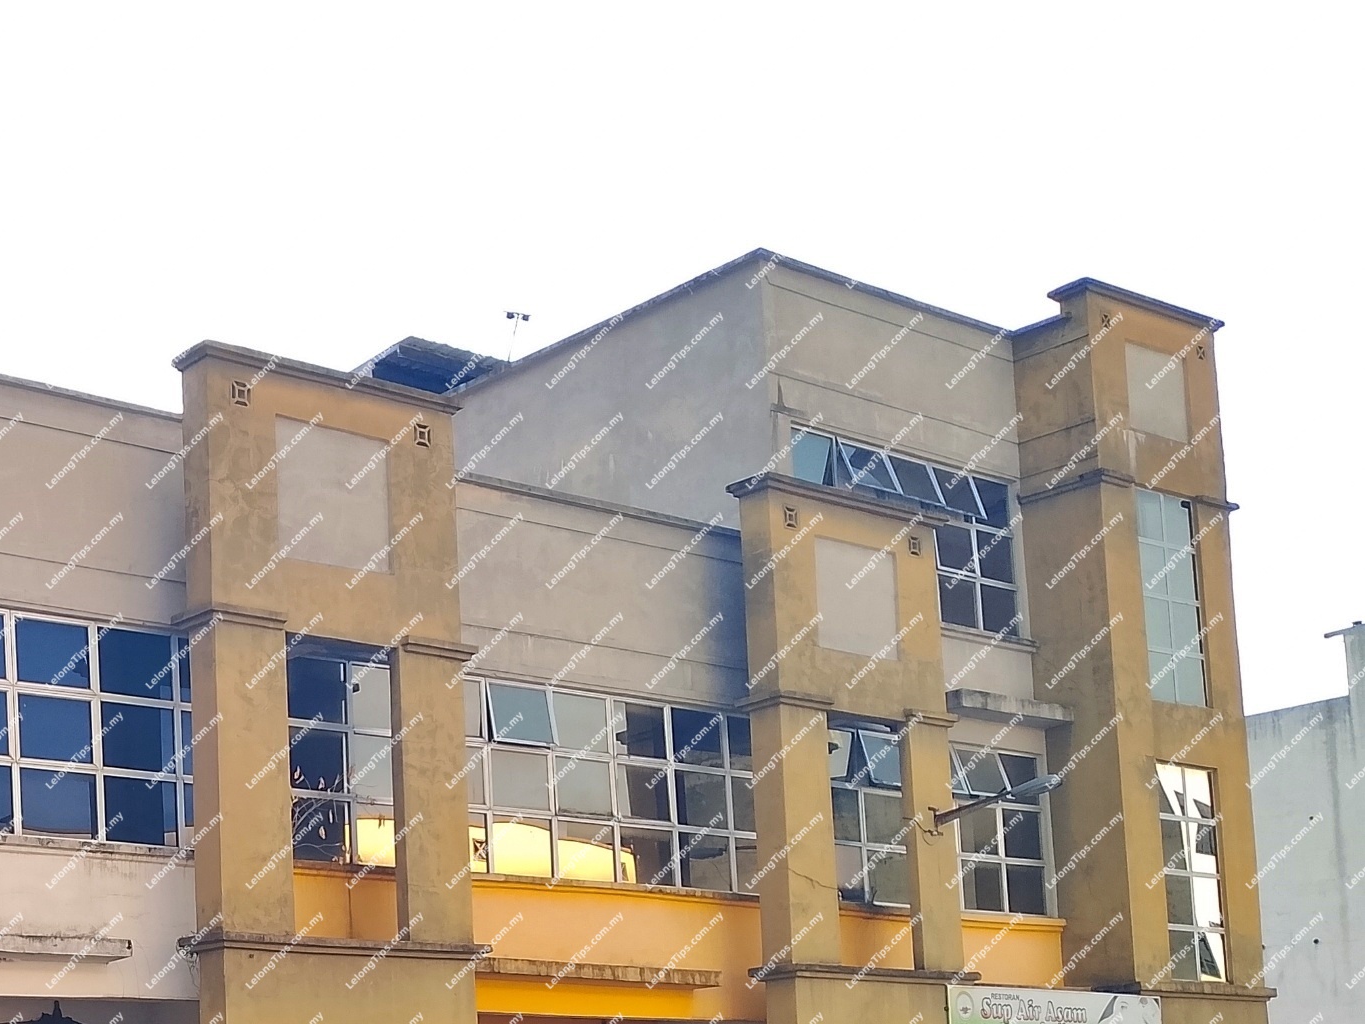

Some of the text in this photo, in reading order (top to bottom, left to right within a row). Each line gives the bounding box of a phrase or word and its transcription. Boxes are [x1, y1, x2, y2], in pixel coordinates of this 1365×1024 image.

[990, 993, 1020, 1001] RESTORAN
[981, 997, 1088, 1024] Sup Air Asam
